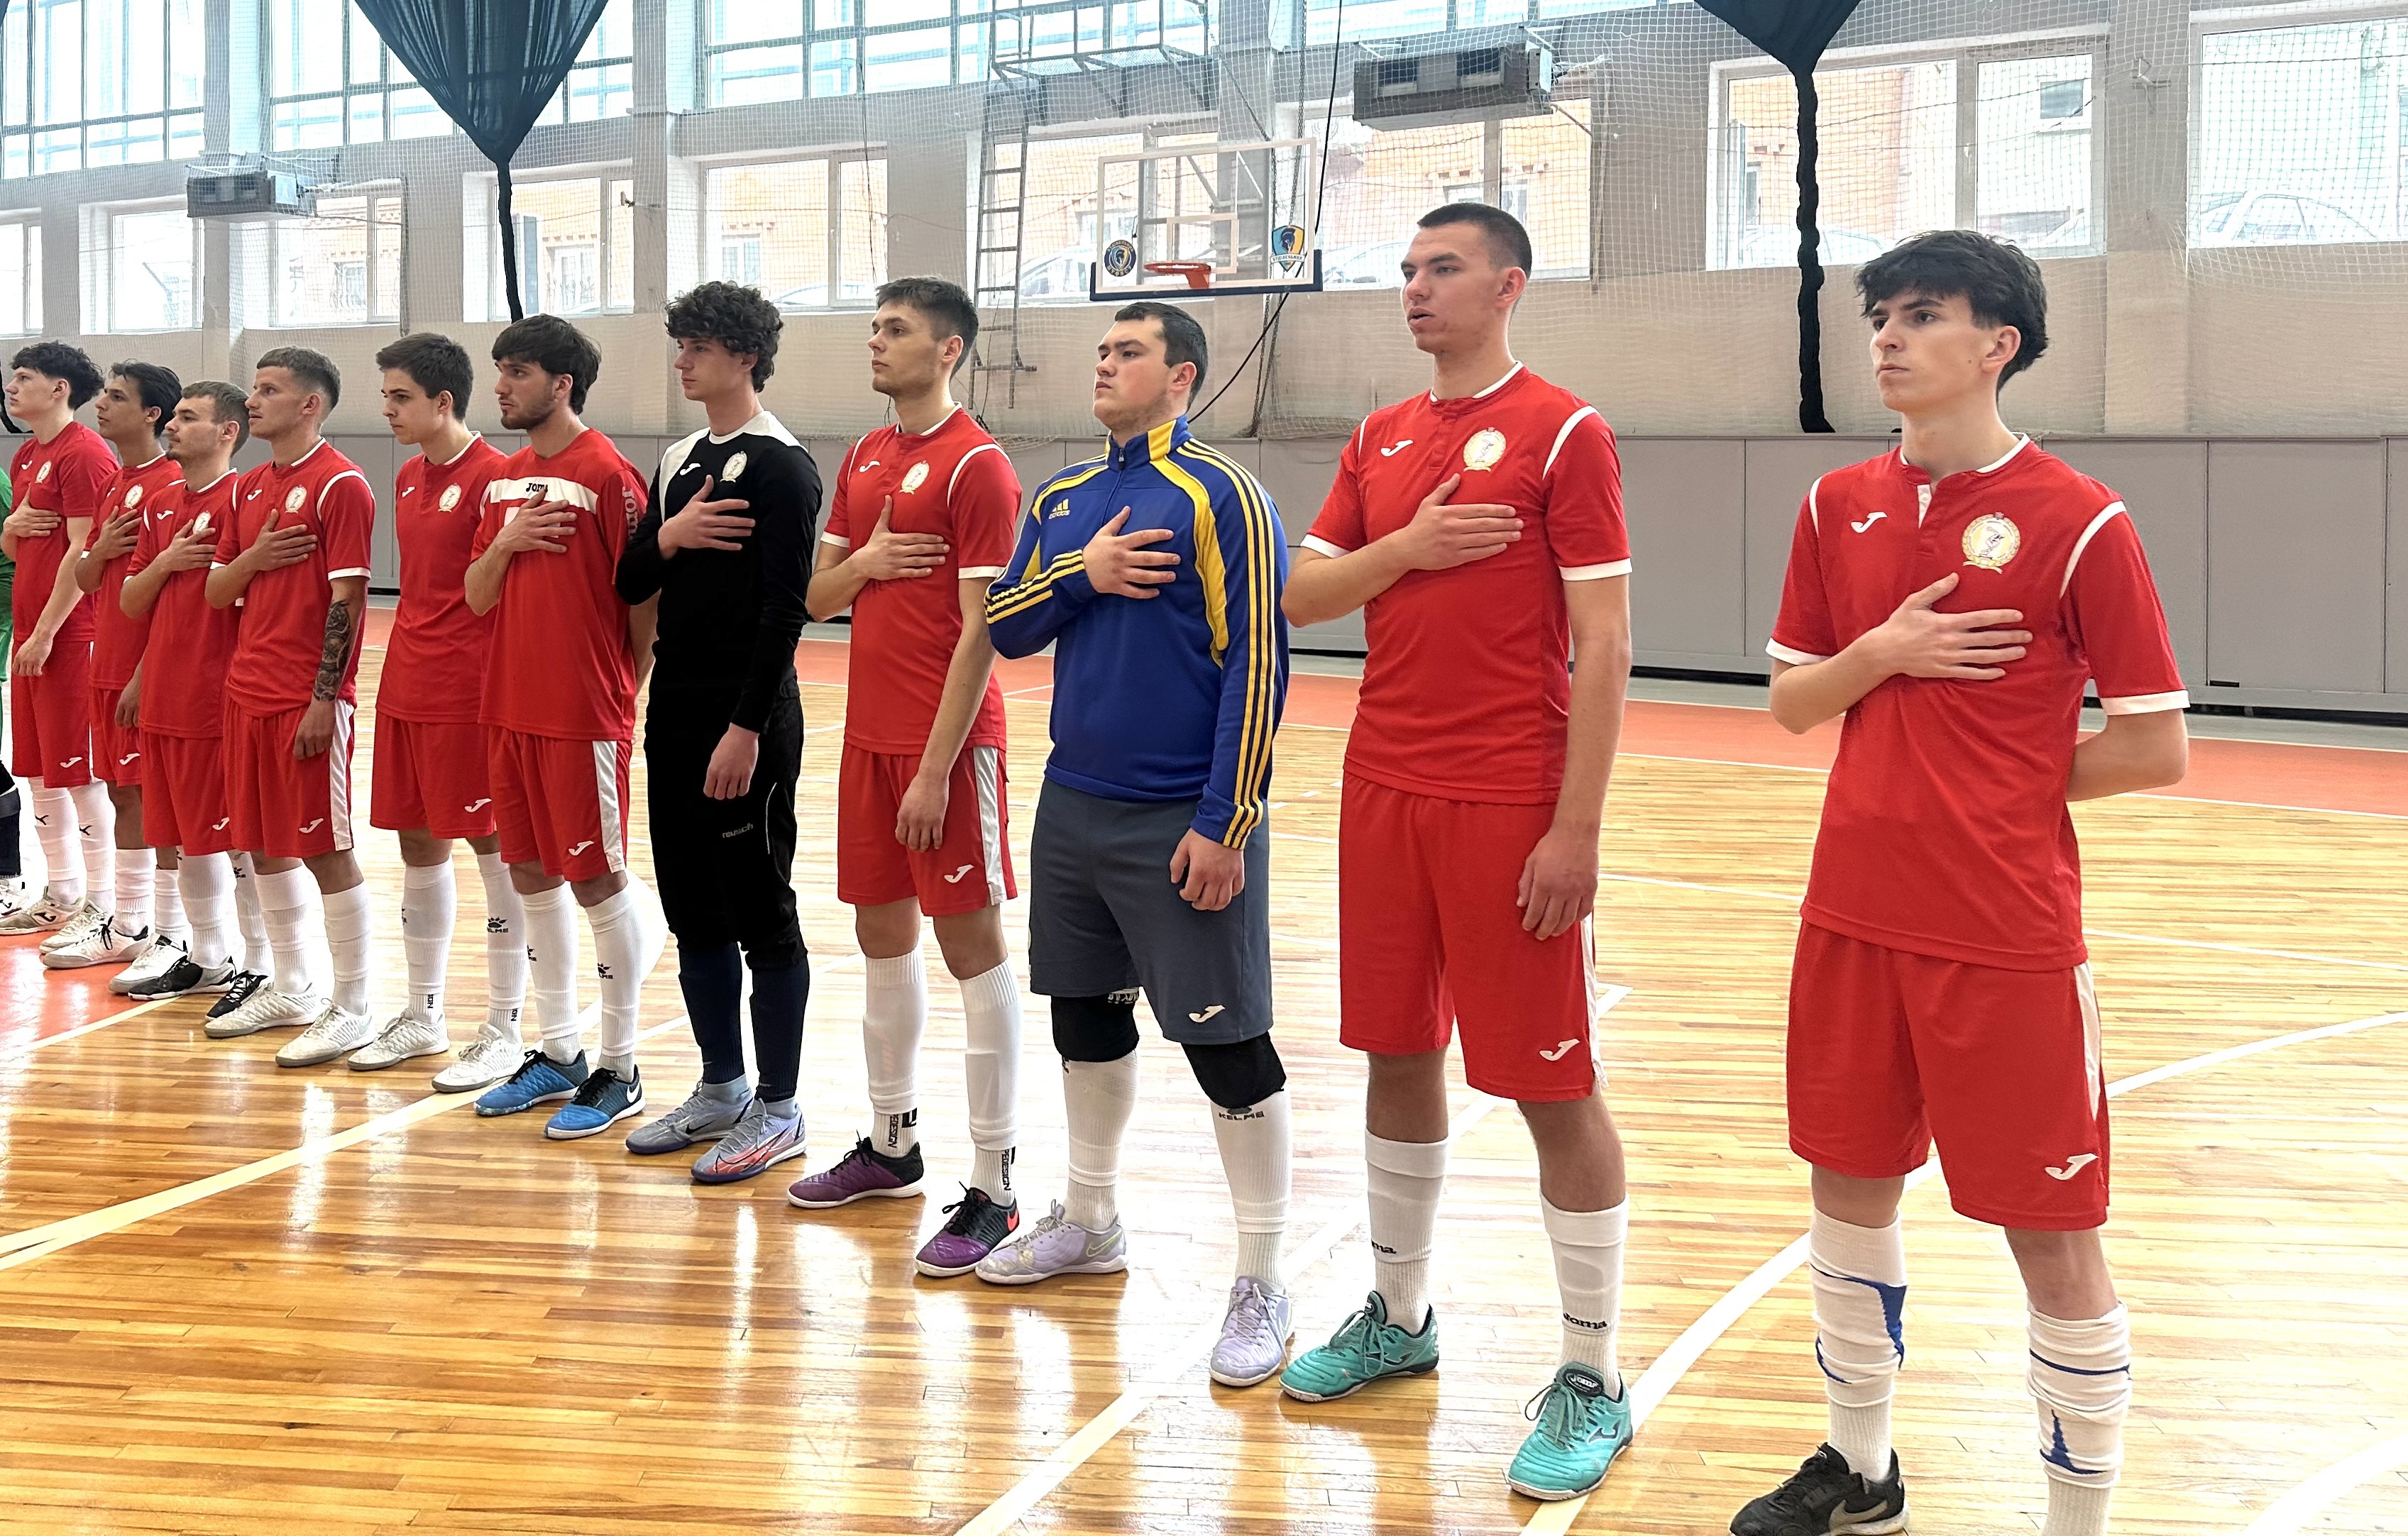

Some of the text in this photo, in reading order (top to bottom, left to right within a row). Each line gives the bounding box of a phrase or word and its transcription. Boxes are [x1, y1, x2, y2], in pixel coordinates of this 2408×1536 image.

[622, 486, 639, 541] Jom
[722, 822, 754, 839] reusch
[1218, 1110, 1265, 1121] KELME
[1563, 1312, 1607, 1330] Joma
